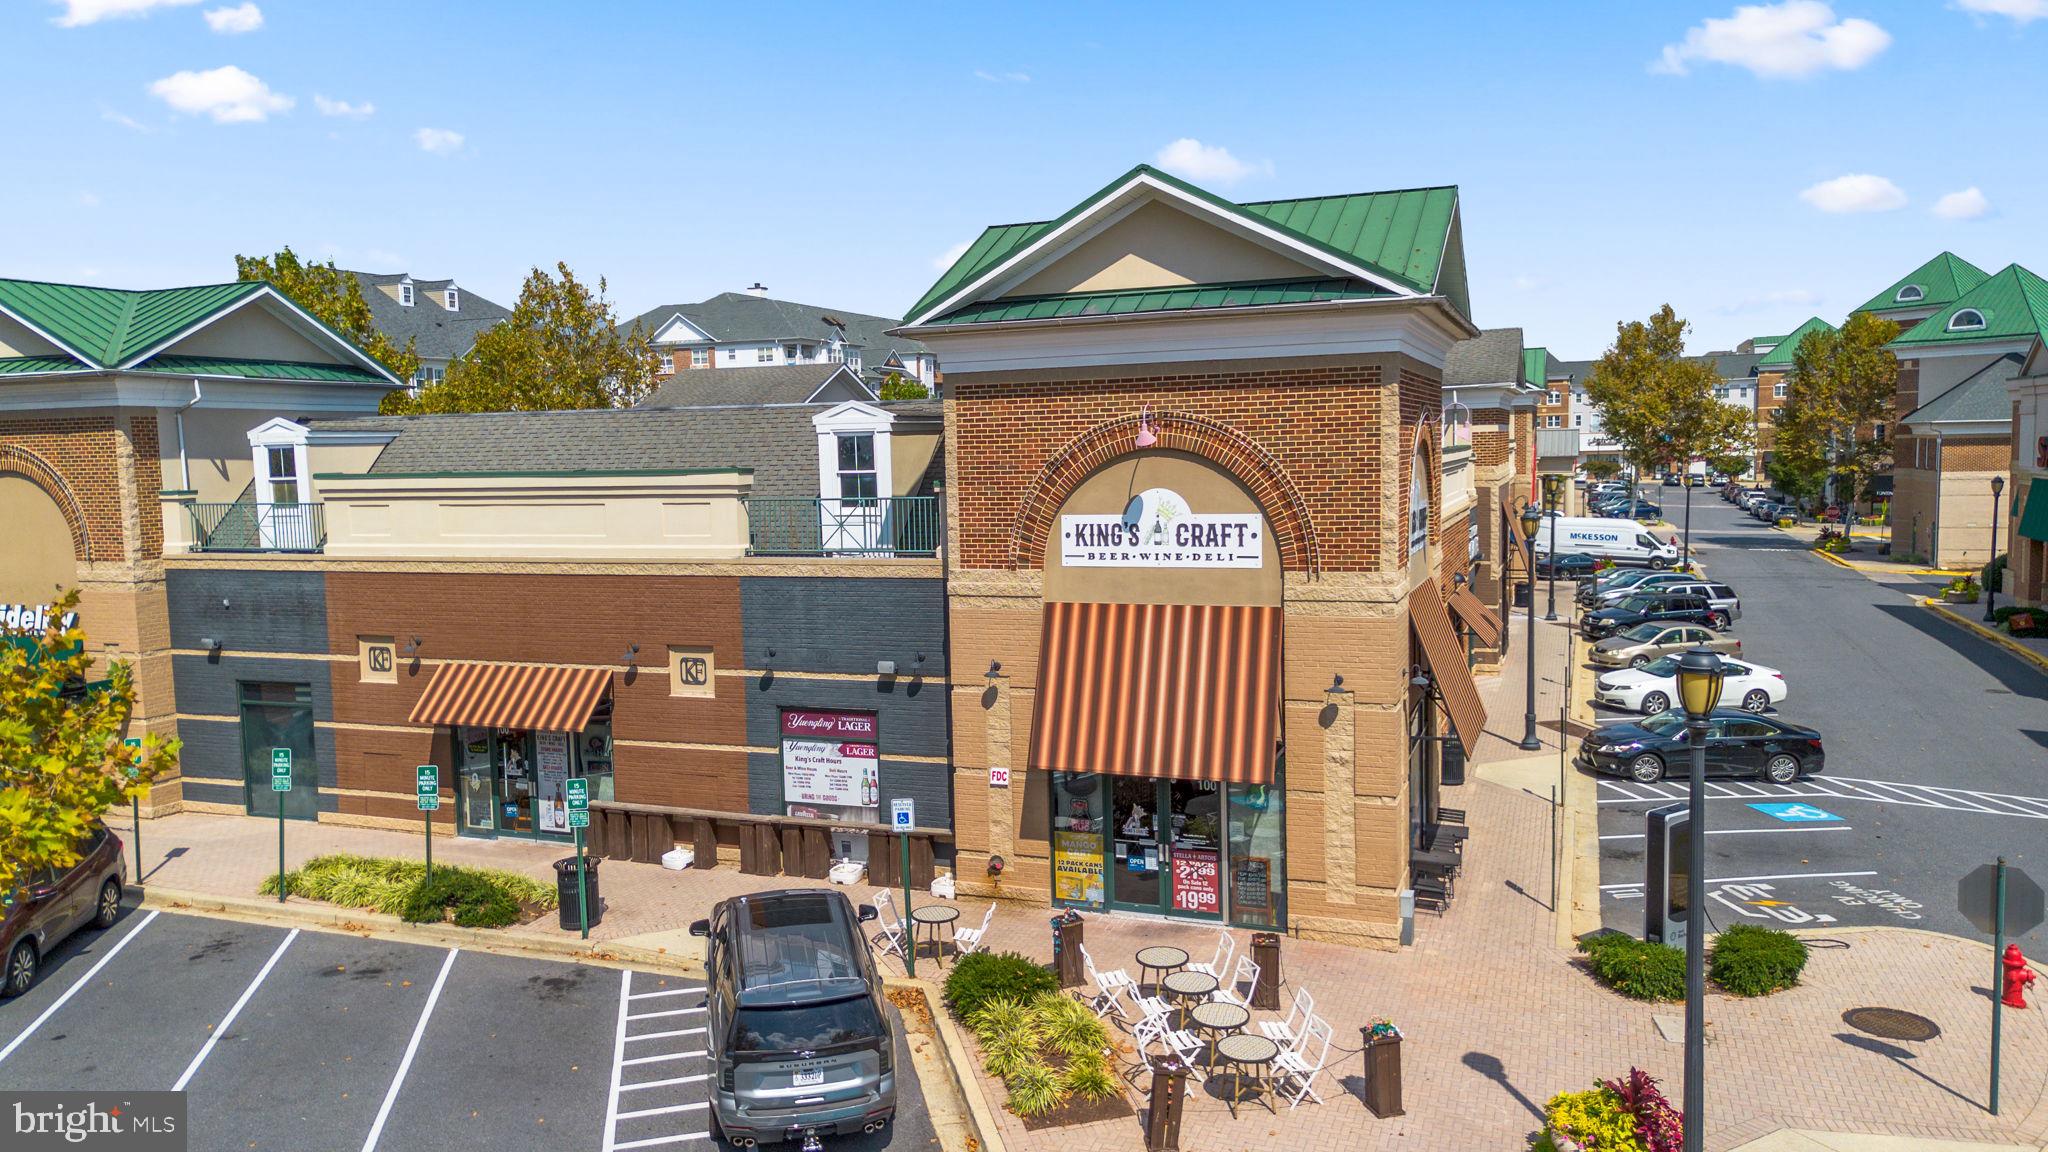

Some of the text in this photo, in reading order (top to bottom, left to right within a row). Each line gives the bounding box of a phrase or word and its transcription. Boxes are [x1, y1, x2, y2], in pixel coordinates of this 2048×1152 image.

[1074, 523, 1248, 547] KING'S CRAFT
[1087, 552, 1234, 561] BEER WINE DELI
[787, 713, 871, 732] Yuengling LAGER
[785, 740, 875, 756] Yuengling LAGER
[991, 771, 1007, 781] FDC
[1199, 780, 1217, 791] 100
[1062, 841, 1096, 849] MANGO
[1189, 860, 1215, 868] PACK
[1057, 865, 1103, 875] AVAILABLE
[1828, 880, 1922, 920] CHARGING
[1831, 895, 1866, 906] EV
[779, 1059, 837, 1069] SUBURBAN
